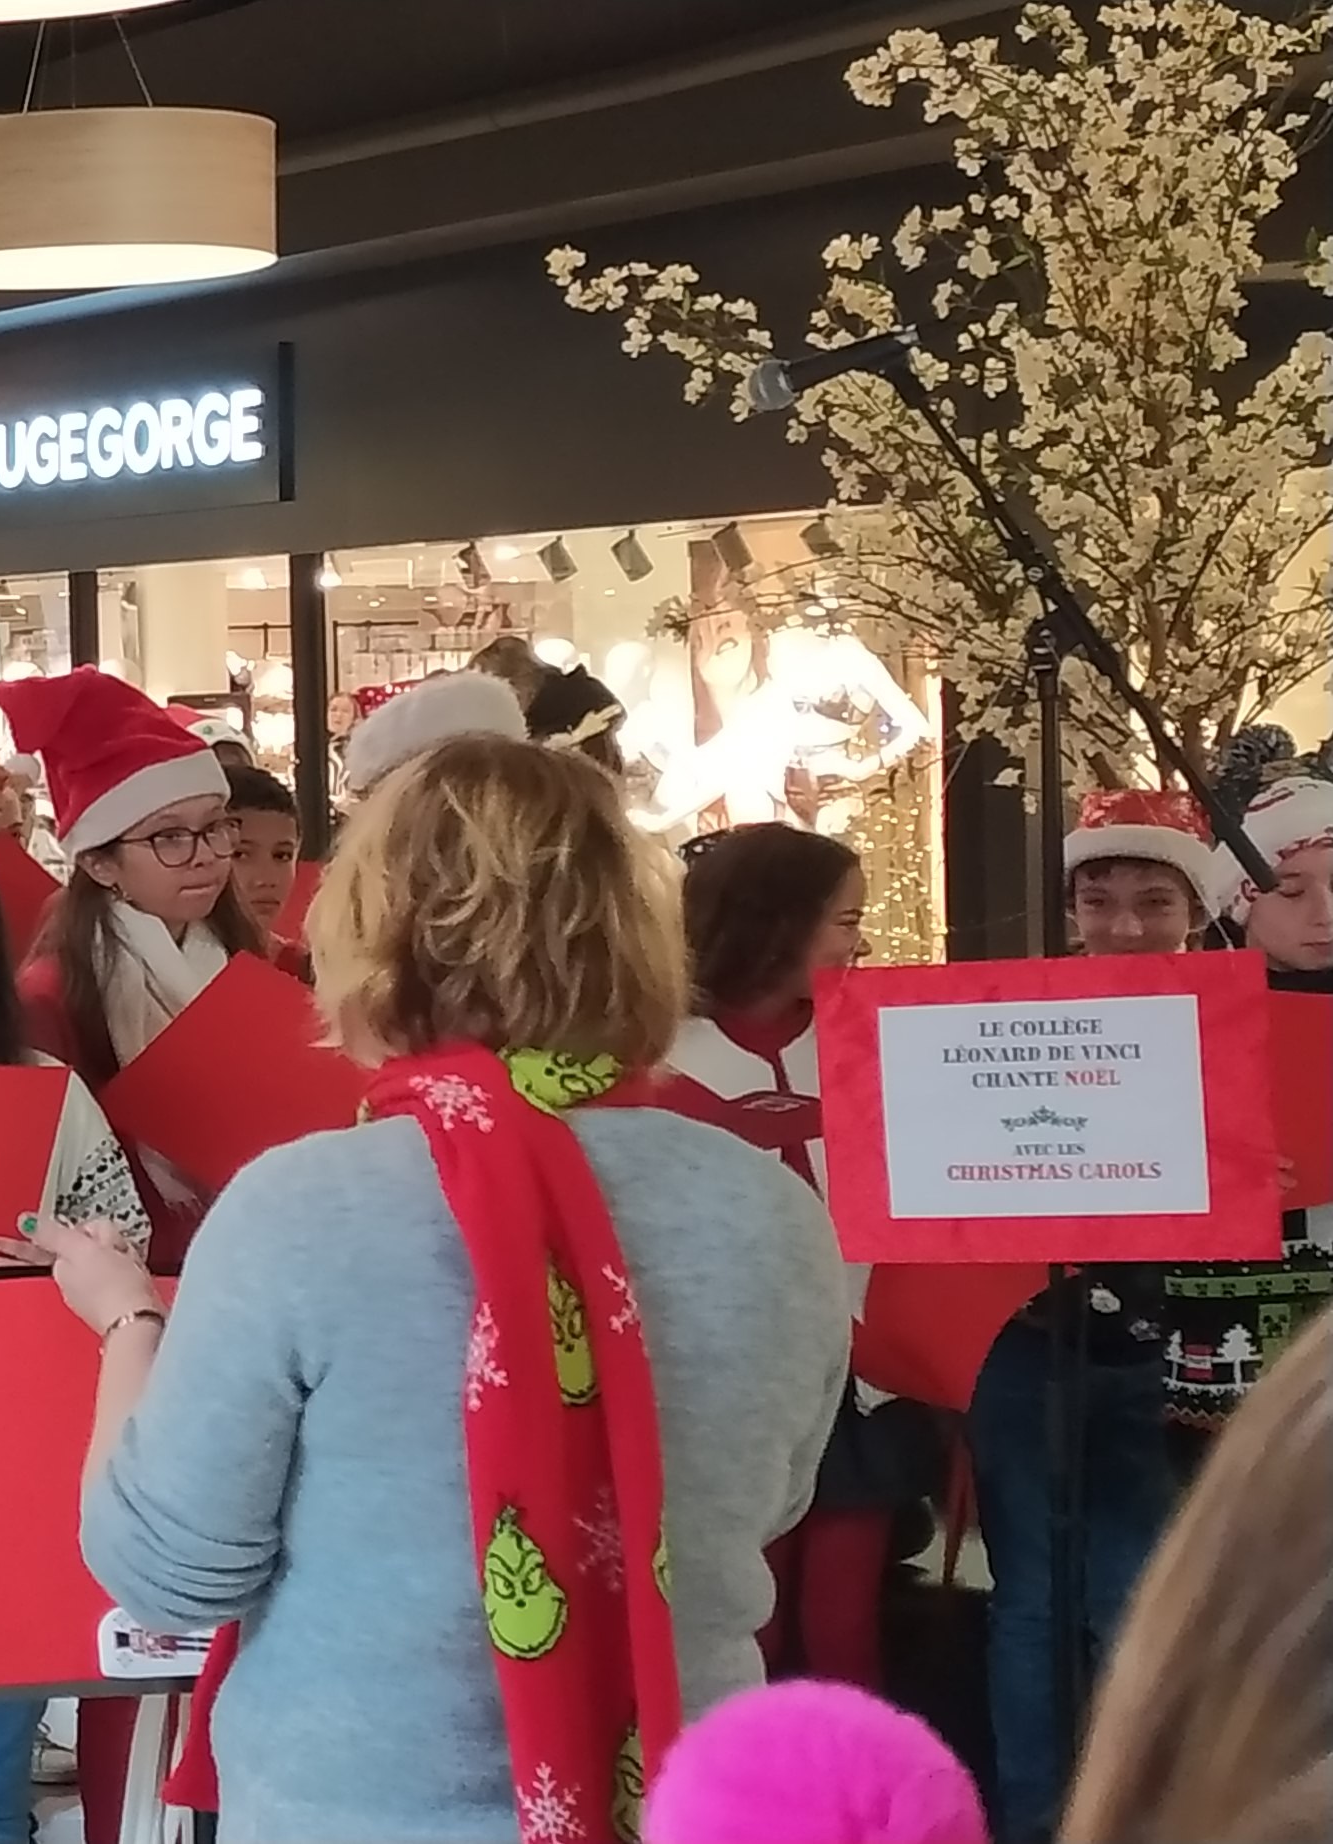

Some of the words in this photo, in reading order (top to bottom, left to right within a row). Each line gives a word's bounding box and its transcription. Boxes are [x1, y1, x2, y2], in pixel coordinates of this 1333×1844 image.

[979, 1021, 1004, 1038] LE
[1010, 1016, 1103, 1037] COLLÈGE
[942, 1044, 1042, 1064] LÉONARD
[1048, 1045, 1076, 1062] DE
[1081, 1043, 1142, 1061] VINCI
[972, 1071, 1059, 1089] CHANTE
[1065, 1068, 1121, 1087] NOËL
[1013, 1143, 1054, 1157] AVEC
[1057, 1142, 1086, 1156] LES
[946, 1163, 1074, 1182] CHRISTMAS
[1078, 1161, 1163, 1180] CAROLS
